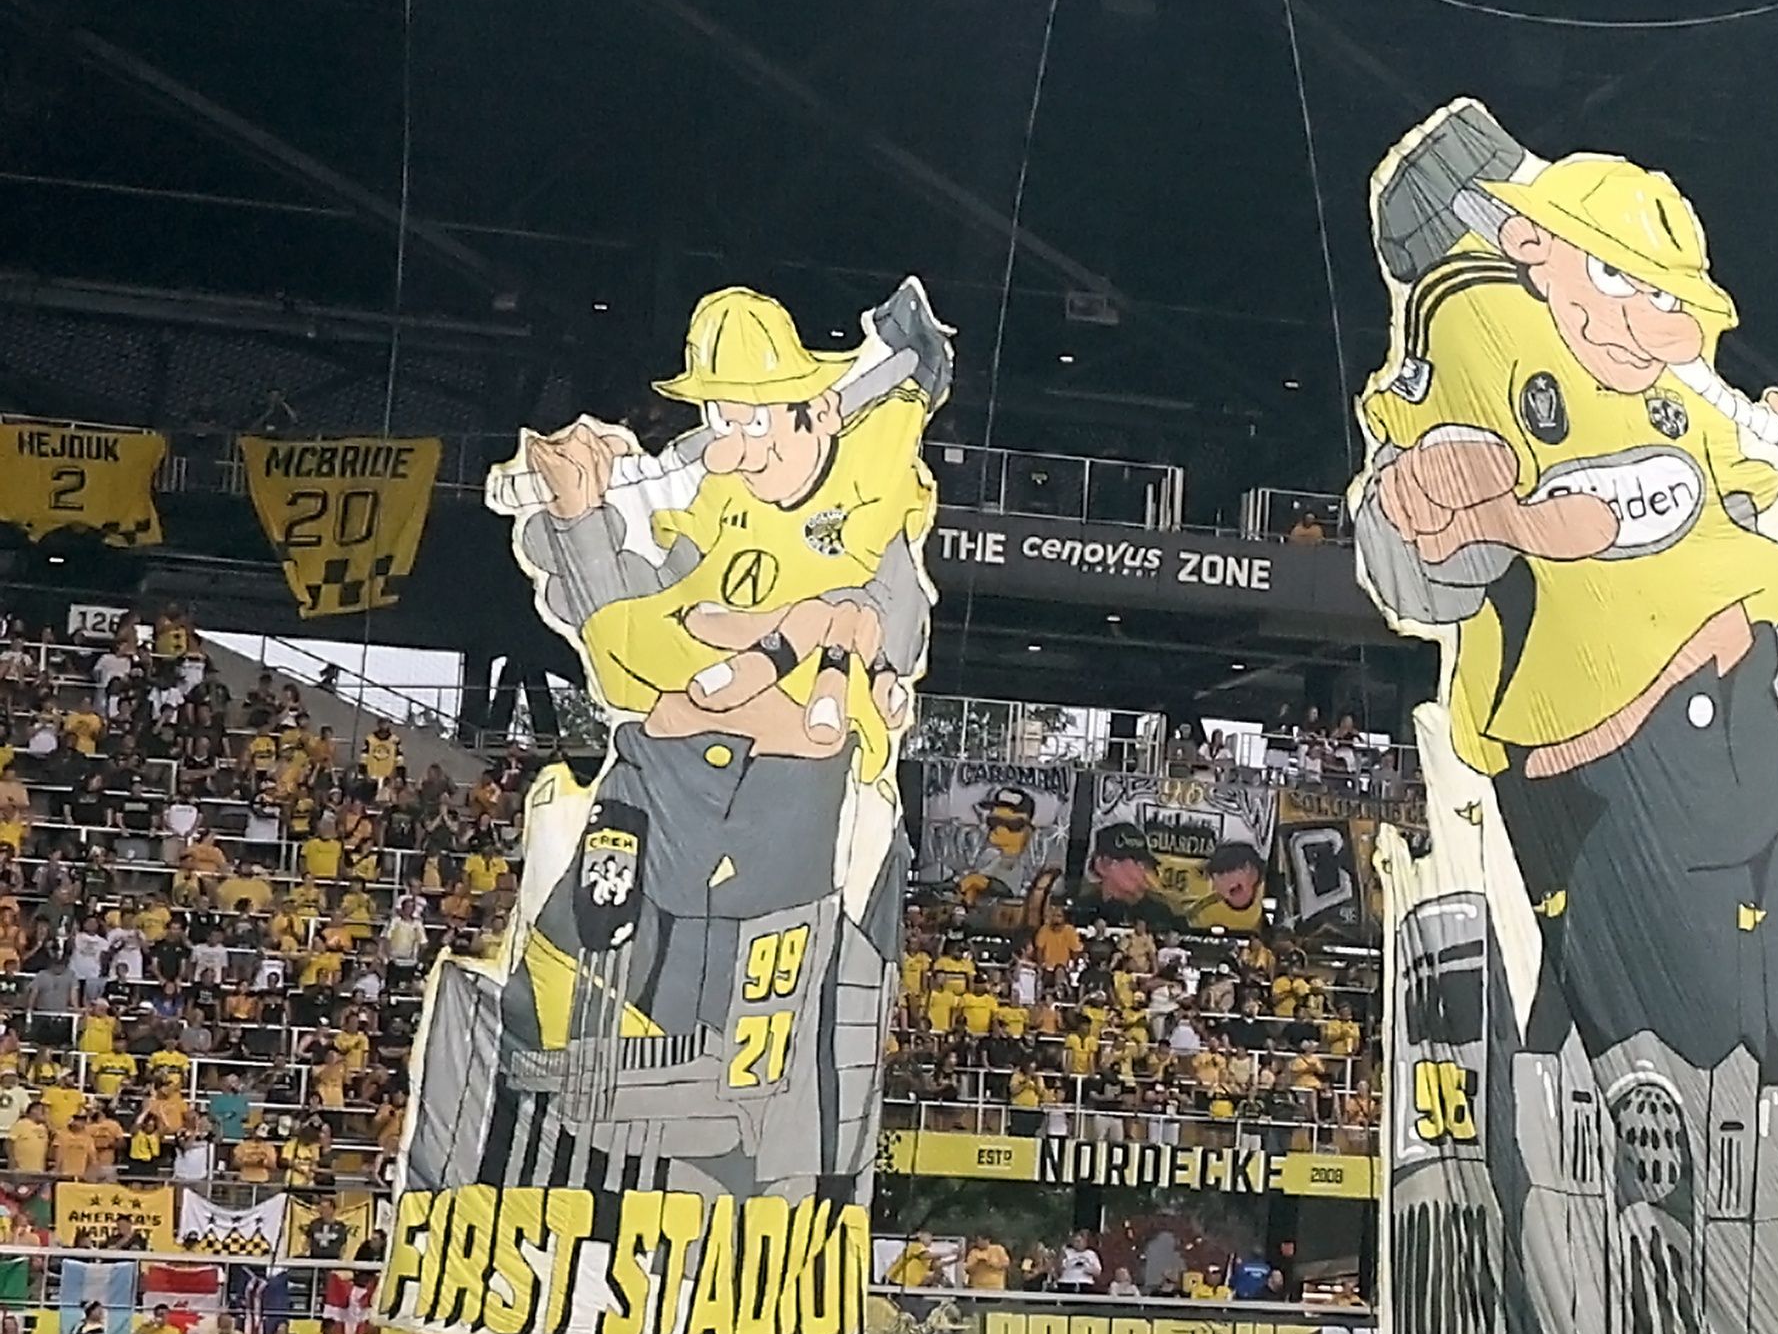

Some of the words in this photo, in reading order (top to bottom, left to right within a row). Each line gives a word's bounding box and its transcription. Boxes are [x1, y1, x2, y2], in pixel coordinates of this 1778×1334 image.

[17, 430, 119, 462] HEJDUK
[265, 444, 415, 479] MCBRIDE
[49, 466, 87, 511] 2
[284, 489, 380, 548] 20
[938, 527, 1007, 565] THE
[1022, 534, 1162, 567] cenovus
[1177, 550, 1272, 591] ZONE
[742, 923, 811, 1002] 99
[727, 1009, 795, 1089] 21
[1414, 1060, 1478, 1142] 96
[1040, 1137, 1283, 1193] NORDECKE
